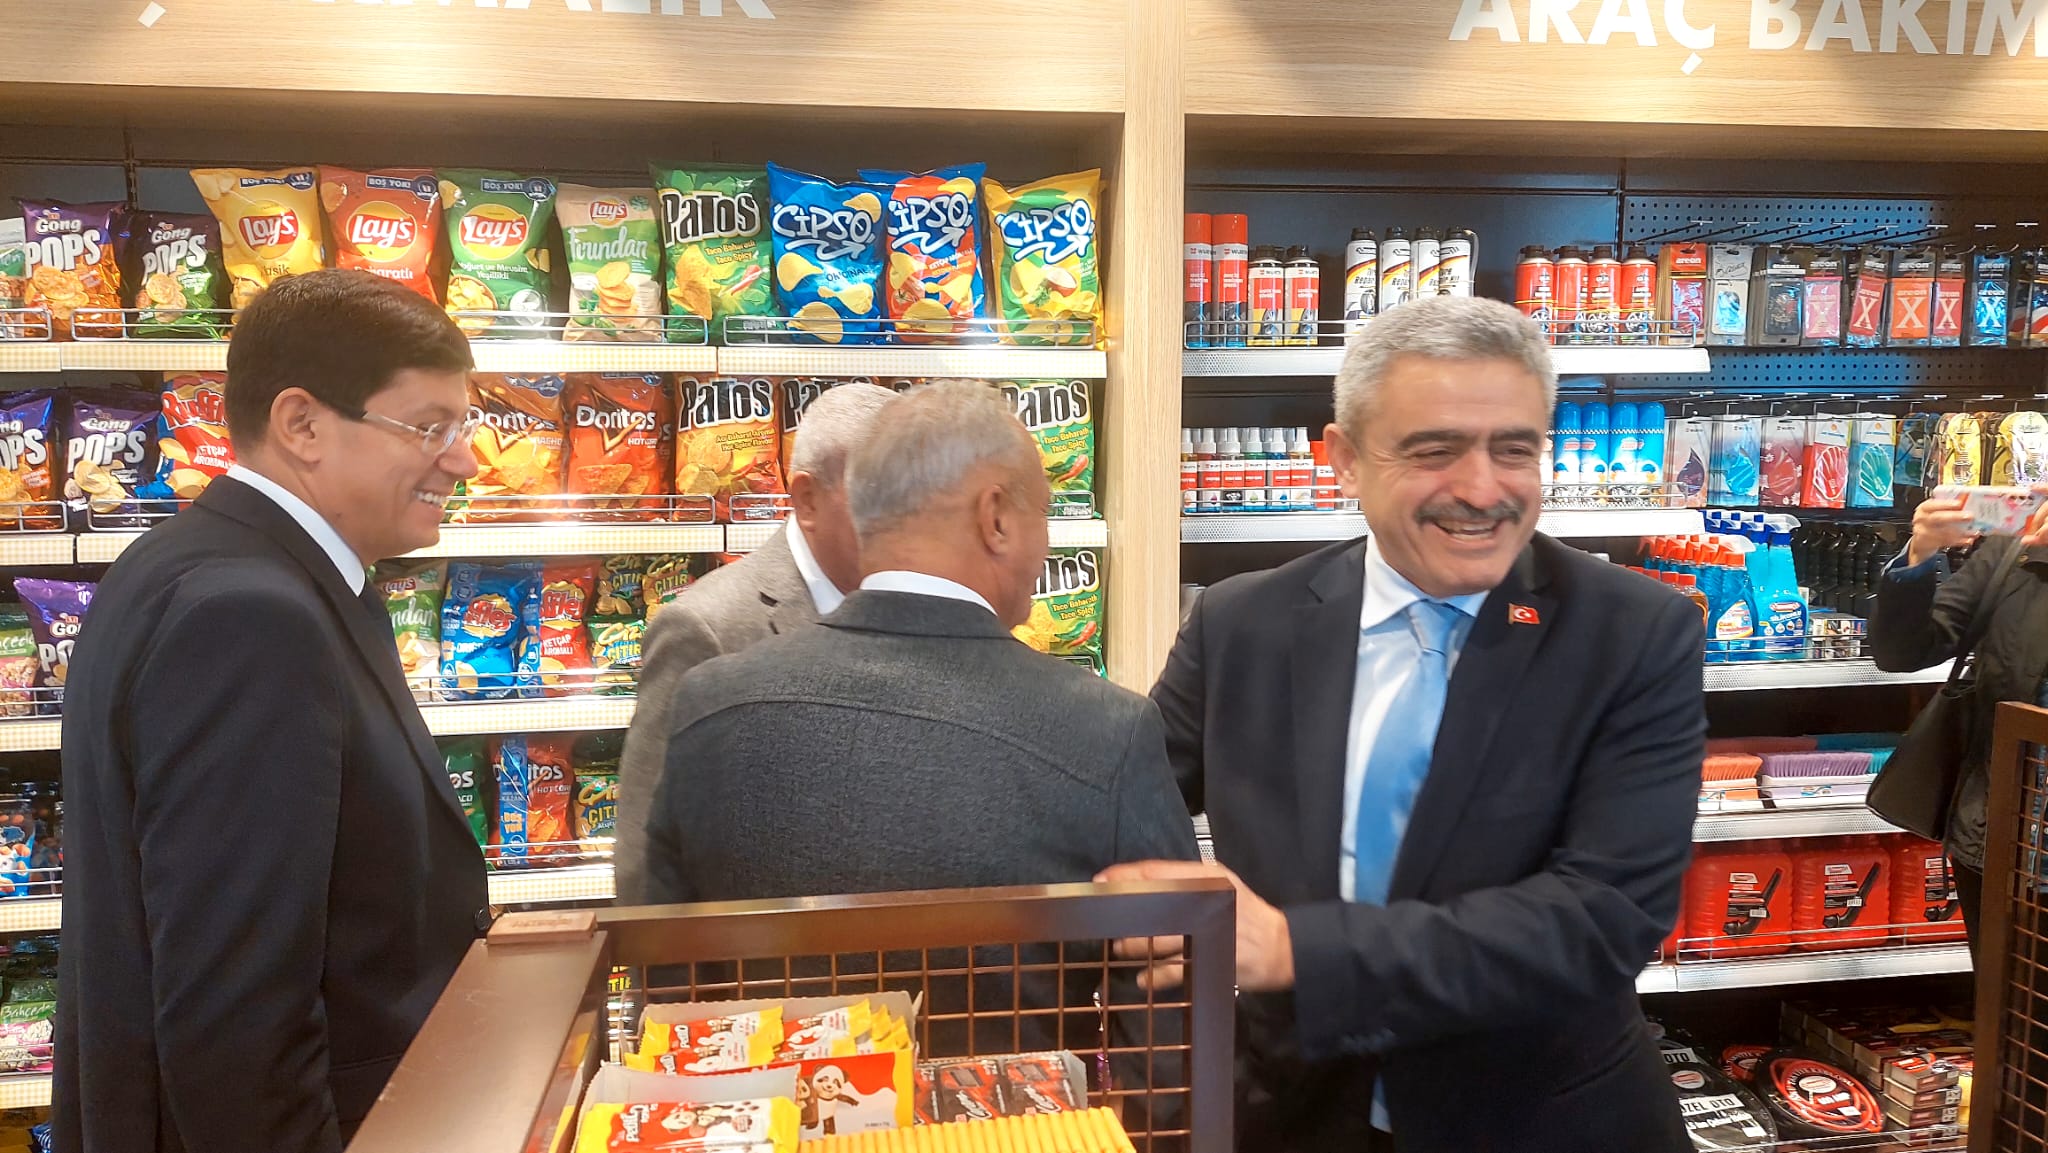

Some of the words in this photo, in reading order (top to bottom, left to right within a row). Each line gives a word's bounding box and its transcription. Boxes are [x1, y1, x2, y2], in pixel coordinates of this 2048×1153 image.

[1448, 0, 1715, 75] ARAÇ
[1748, 0, 2048, 57] BAKIM
[368, 178, 387, 188] BOŞ
[389, 180, 411, 189] YOK!
[483, 182, 501, 191] BOŞ
[36, 218, 81, 233] Gong
[592, 201, 627, 219] Lay's
[151, 226, 192, 244] Gong
[243, 212, 297, 247] Lay's
[351, 215, 414, 248] Lay's
[463, 217, 524, 247] Lay's
[25, 228, 101, 279] POPS
[142, 234, 207, 286] POPS
[1852, 295, 1880, 330] X
[1896, 296, 1926, 329] X
[1936, 298, 1960, 330] X
[1977, 296, 2004, 328] X
[576, 404, 657, 430] Doritos
[0, 428, 47, 471] OPS
[67, 430, 147, 474] POPS
[1709, 1097, 1736, 1109] OTO
